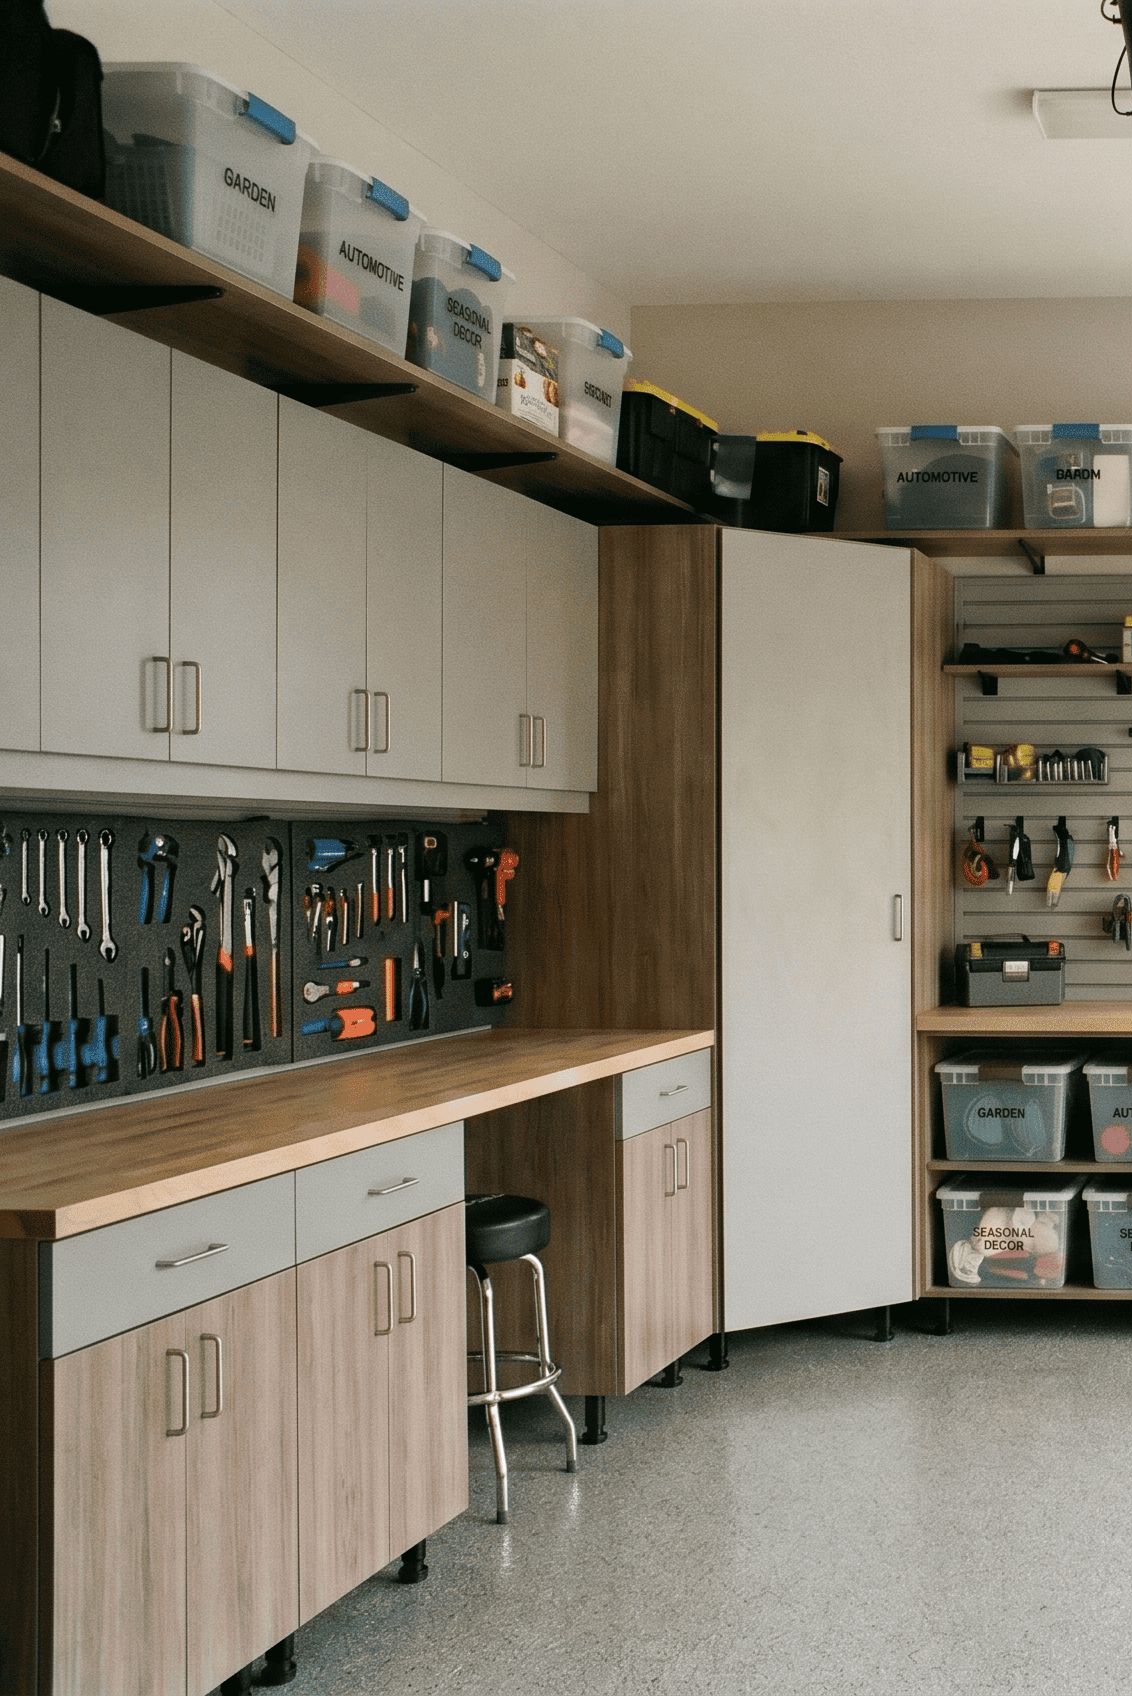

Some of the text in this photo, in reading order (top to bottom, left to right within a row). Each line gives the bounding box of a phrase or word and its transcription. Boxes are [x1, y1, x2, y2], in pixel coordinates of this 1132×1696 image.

[224, 168, 276, 212] GARDEN
[339, 240, 405, 292] AUTOMOTIVE
[896, 471, 979, 483] AUTOMOTIVE
[977, 1107, 1025, 1119] GARDEN
[973, 1226, 1034, 1238] SEASONAL
[984, 1240, 1024, 1251] DECOR
